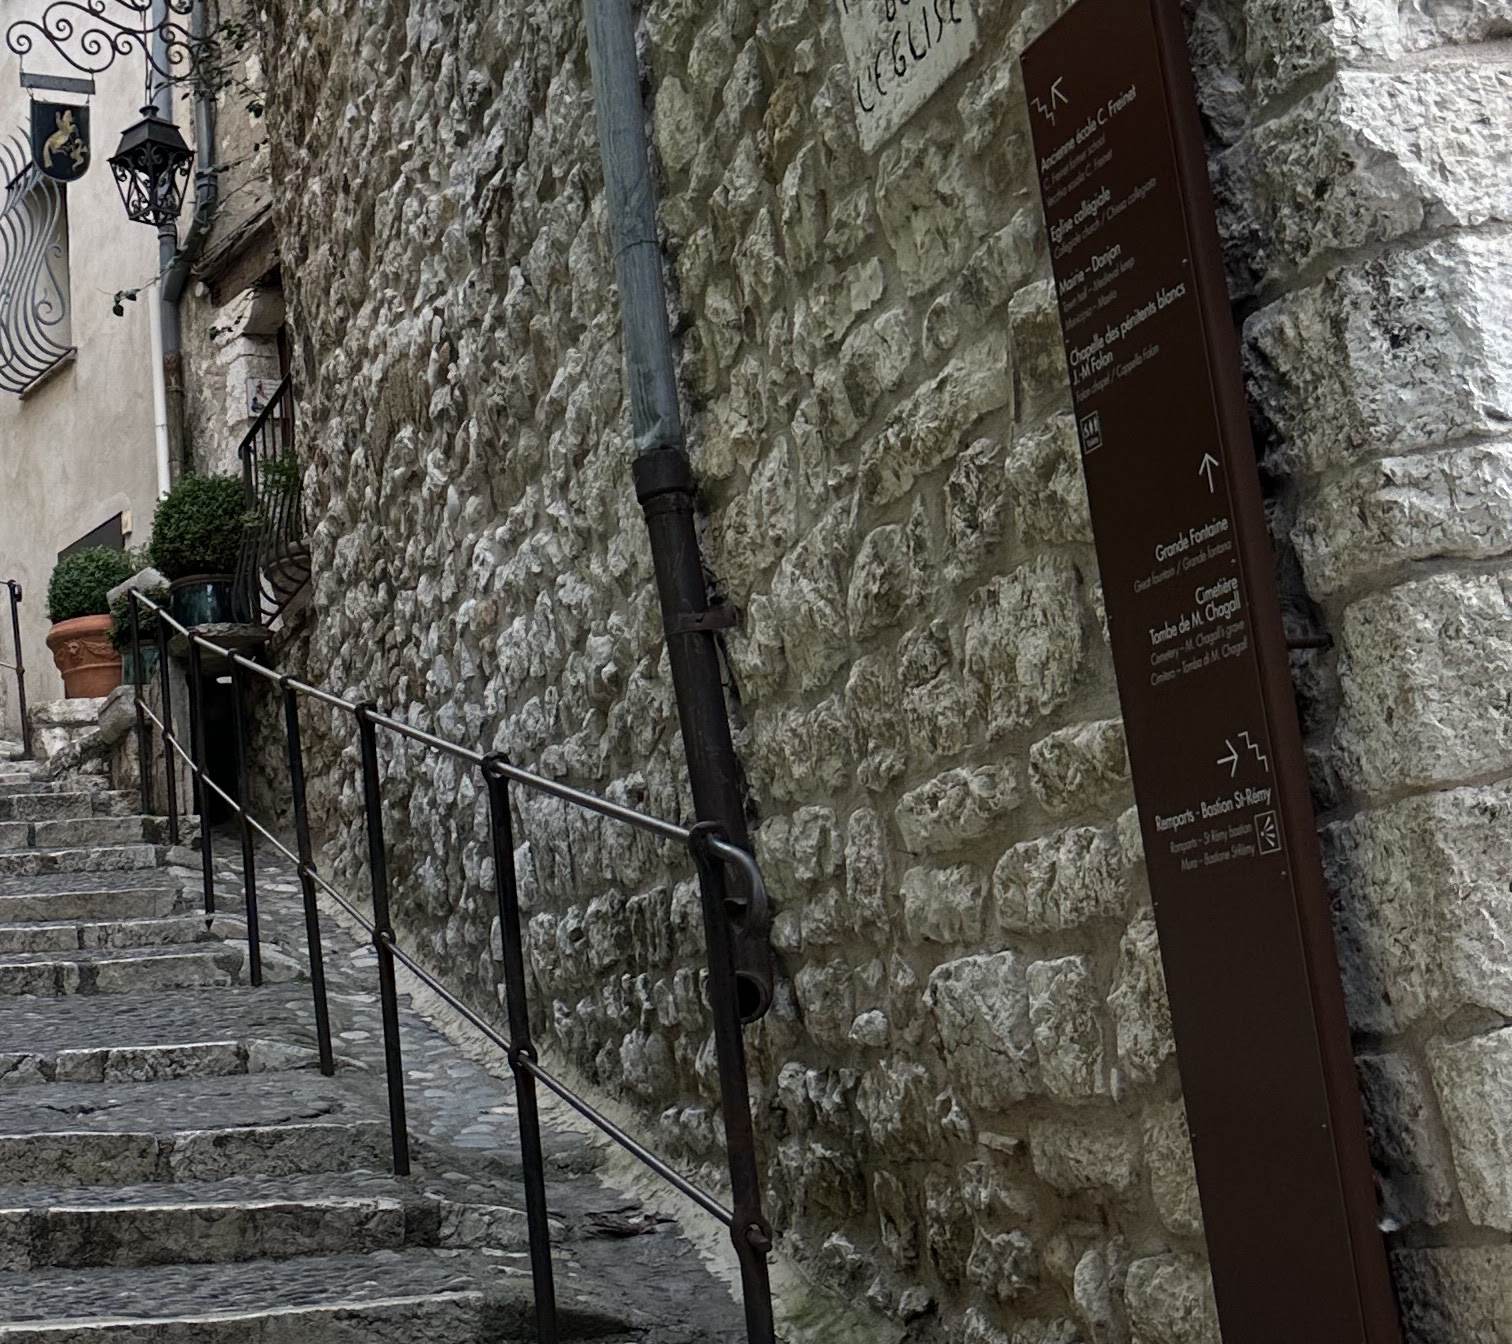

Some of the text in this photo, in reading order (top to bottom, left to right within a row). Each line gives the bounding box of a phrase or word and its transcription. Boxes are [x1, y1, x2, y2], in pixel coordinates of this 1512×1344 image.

[1041, 138, 1075, 173] Ancienne
[1076, 117, 1097, 144] école
[1059, 268, 1084, 296] Mairie
[1091, 244, 1121, 272] Donjon
[1070, 283, 1186, 366] Chapelle des pénitents blancs
[1091, 350, 1113, 373] Folon
[1155, 517, 1229, 561] Grande Fontaine
[1195, 576, 1238, 605] Cimetière
[1149, 590, 1241, 645] Tombe de M. Chagall
[1155, 808, 1195, 832] Remparts
[1201, 796, 1234, 819] Bastion
[1234, 786, 1272, 809] St-Rémy
